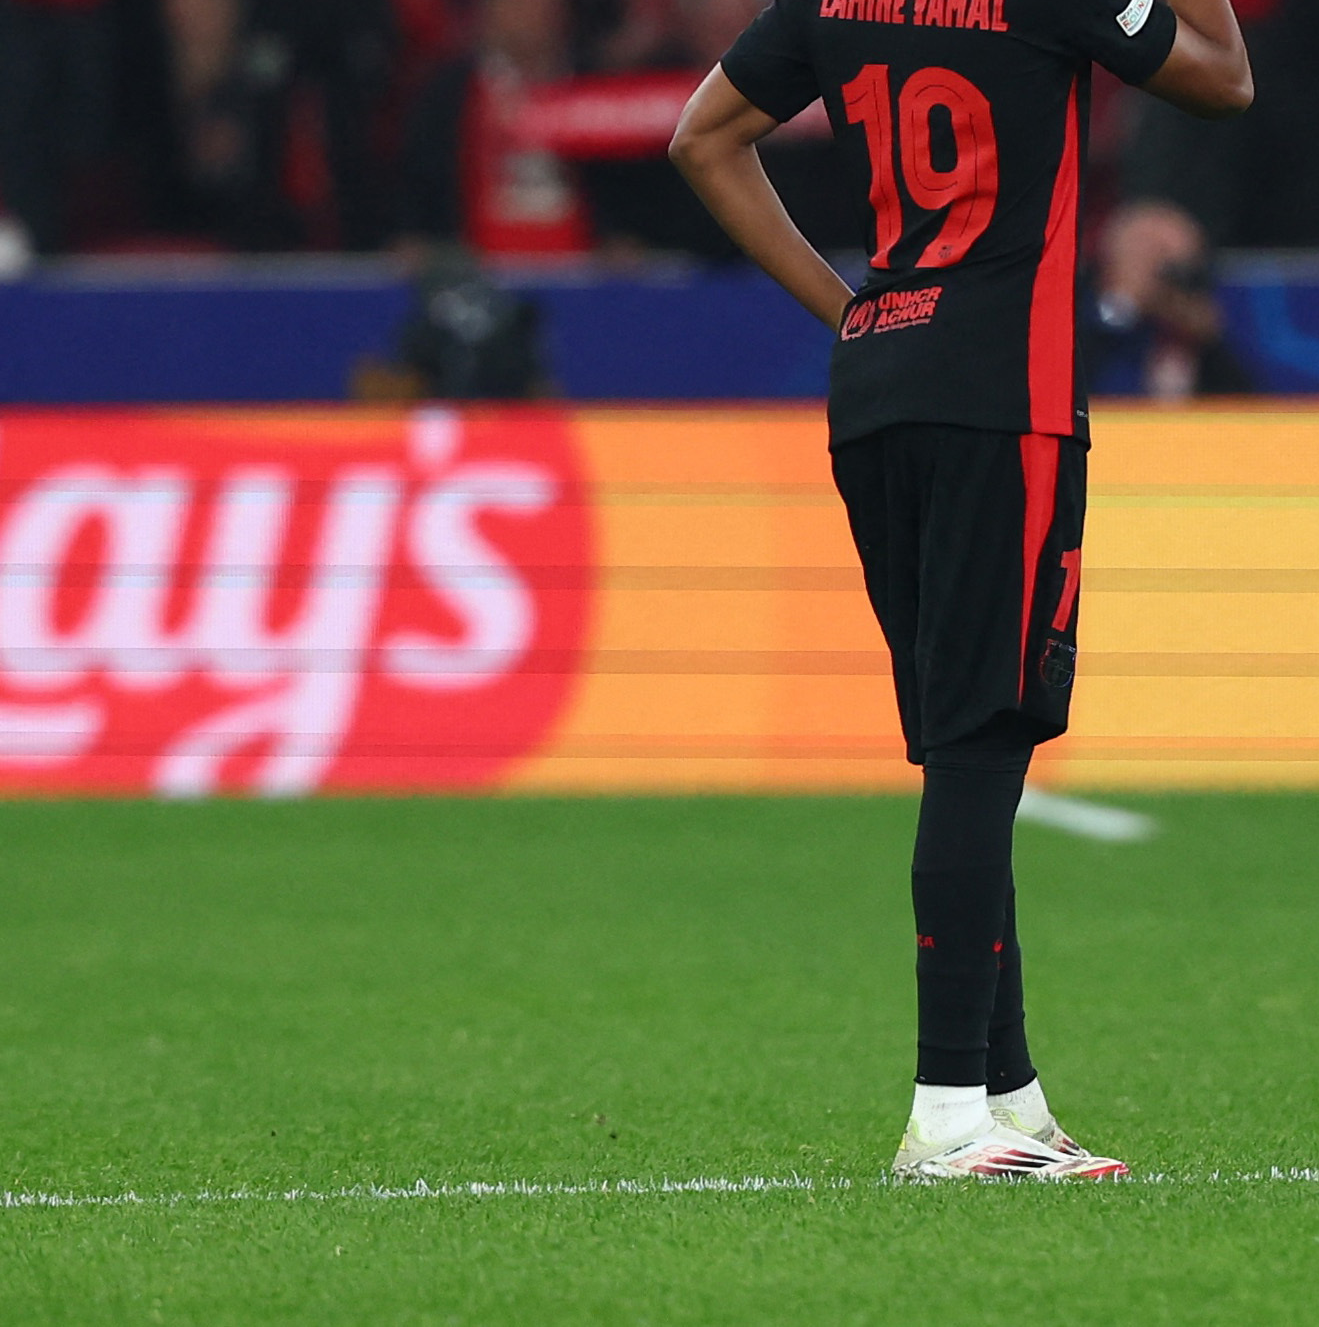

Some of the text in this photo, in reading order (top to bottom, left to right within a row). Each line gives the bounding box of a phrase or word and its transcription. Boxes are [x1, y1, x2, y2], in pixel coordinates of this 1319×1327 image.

[841, 64, 998, 269] 19
[878, 286, 943, 310] UNHCR
[0, 409, 560, 798] ay's
